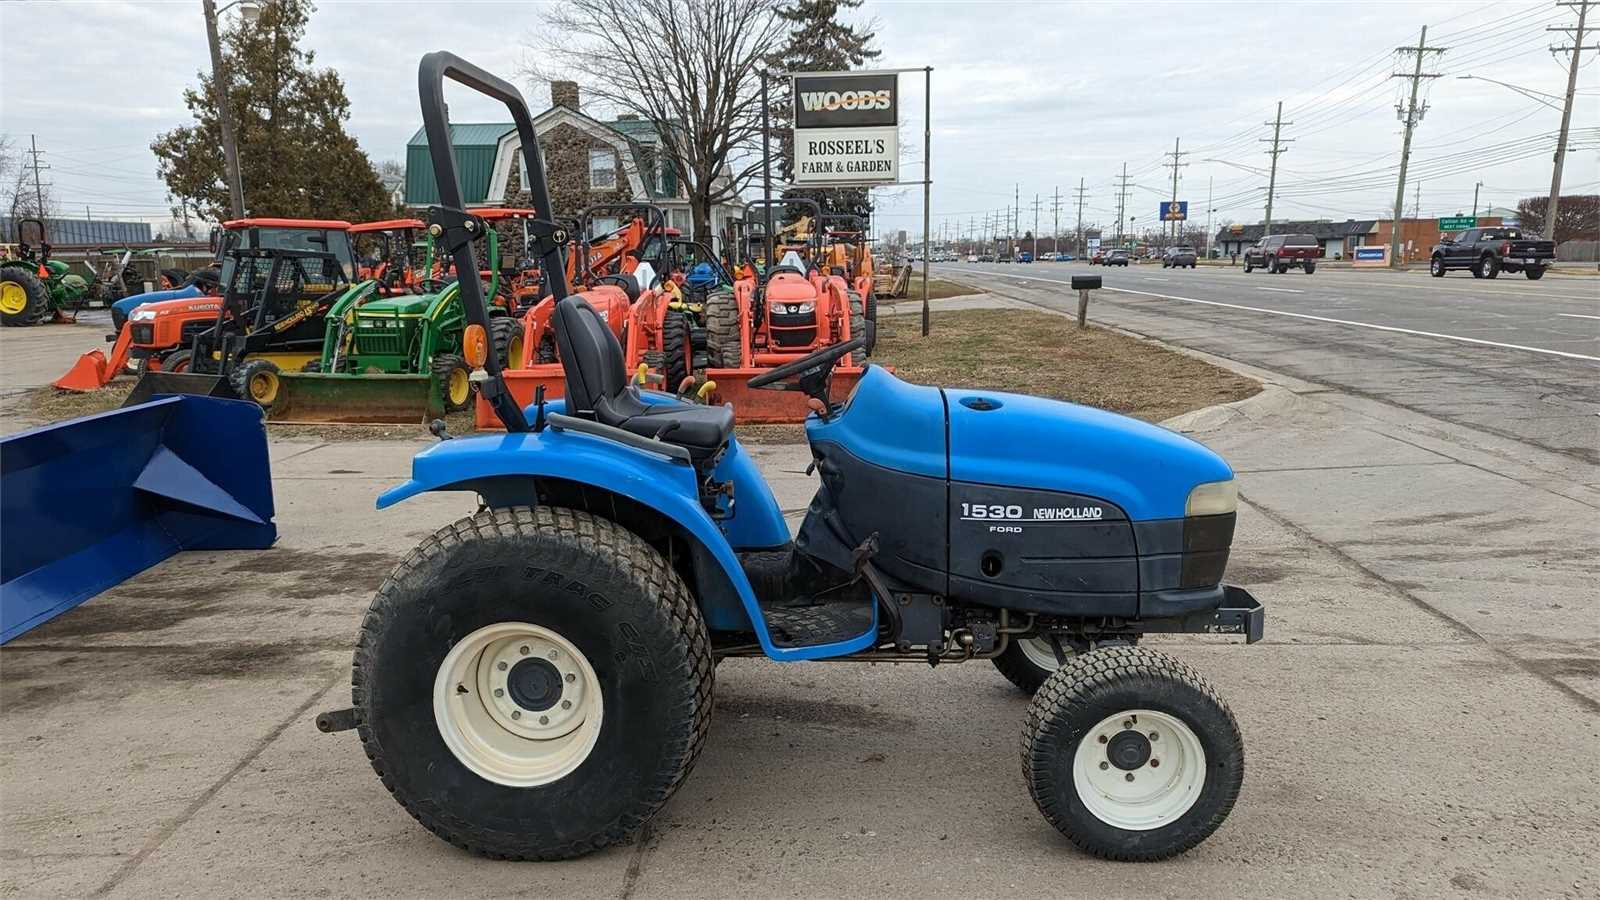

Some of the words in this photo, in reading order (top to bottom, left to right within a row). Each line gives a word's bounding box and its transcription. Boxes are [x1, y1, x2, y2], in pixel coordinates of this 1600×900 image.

[800, 90, 891, 111] WOODS
[808, 139, 885, 155] ROSSEEL'S
[801, 161, 833, 173] FARM
[835, 161, 844, 173] &
[846, 160, 892, 172] GARDEN
[961, 503, 1022, 518] 1530
